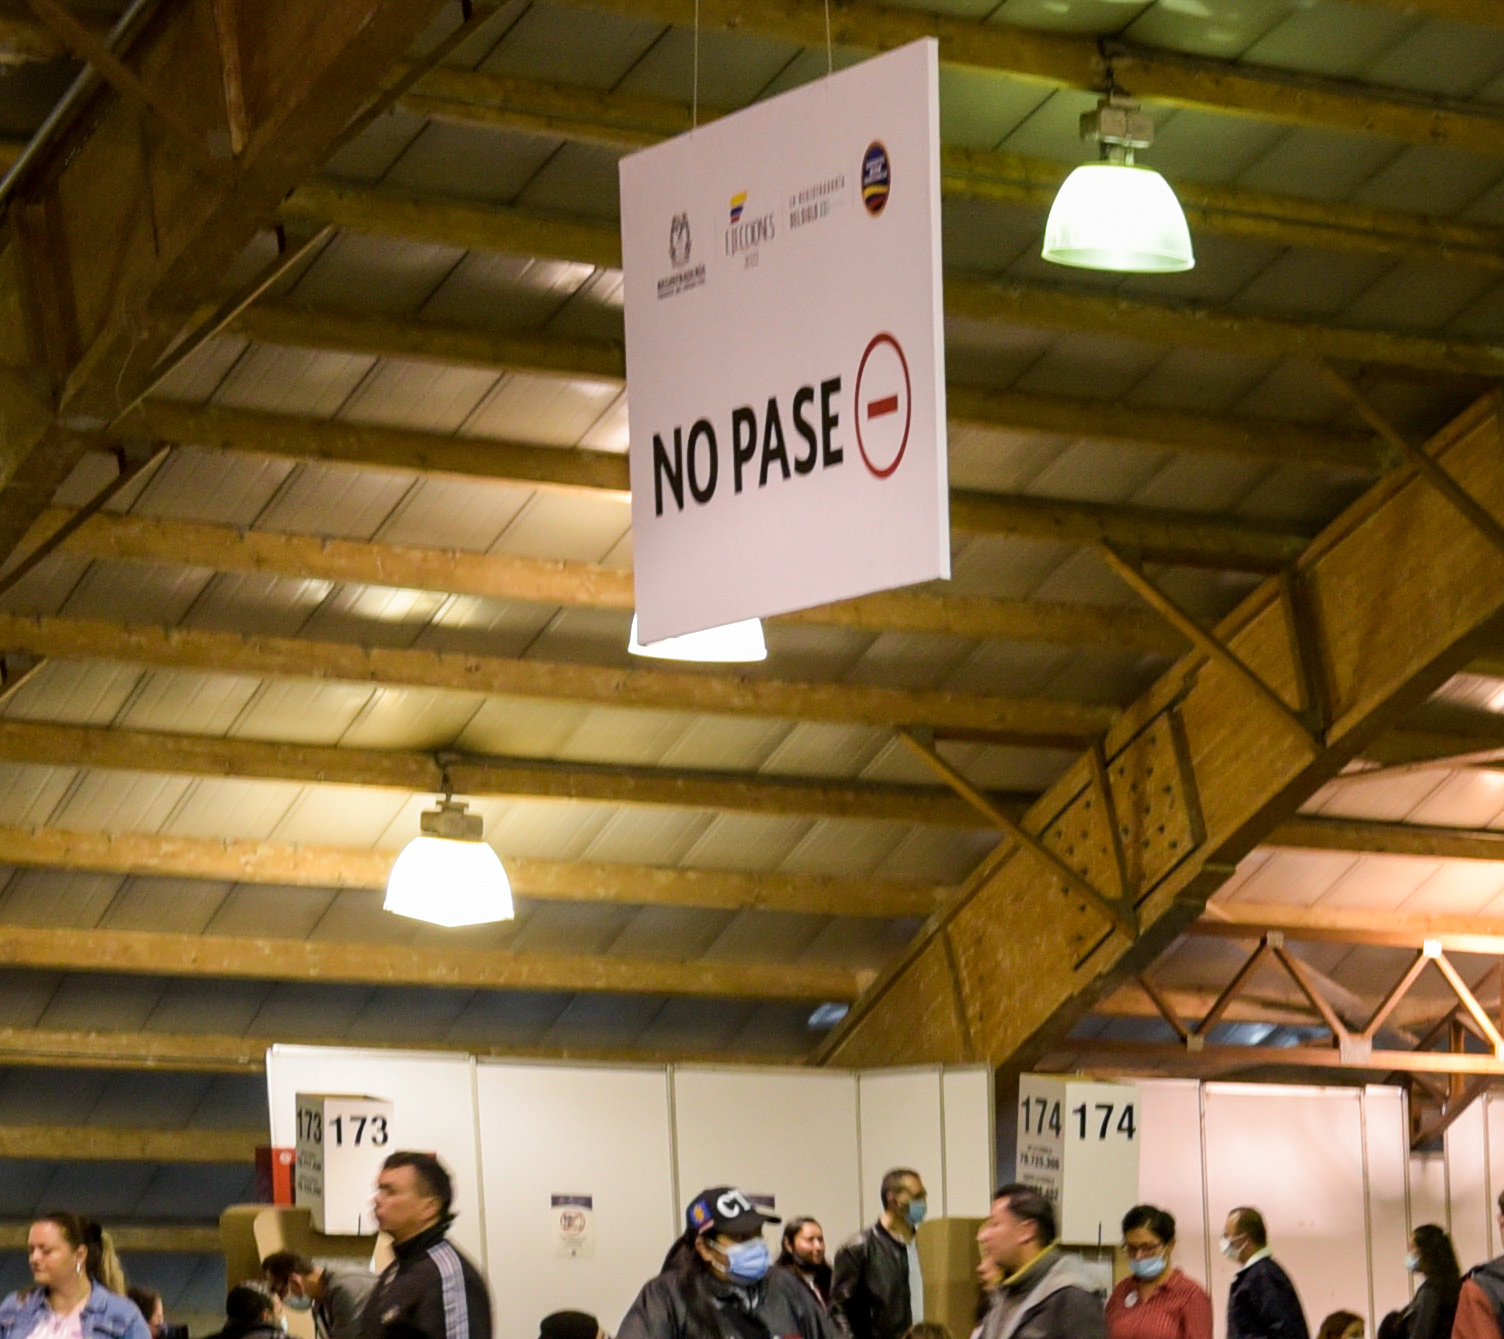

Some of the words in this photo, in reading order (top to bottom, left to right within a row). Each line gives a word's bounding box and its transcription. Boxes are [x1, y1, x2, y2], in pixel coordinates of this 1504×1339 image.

[652, 417, 719, 518] NO
[732, 374, 845, 495] PASE
[297, 1108, 322, 1146] 173
[329, 1114, 390, 1148] 173
[1021, 1096, 1062, 1139] 174
[1072, 1101, 1137, 1142] 174
